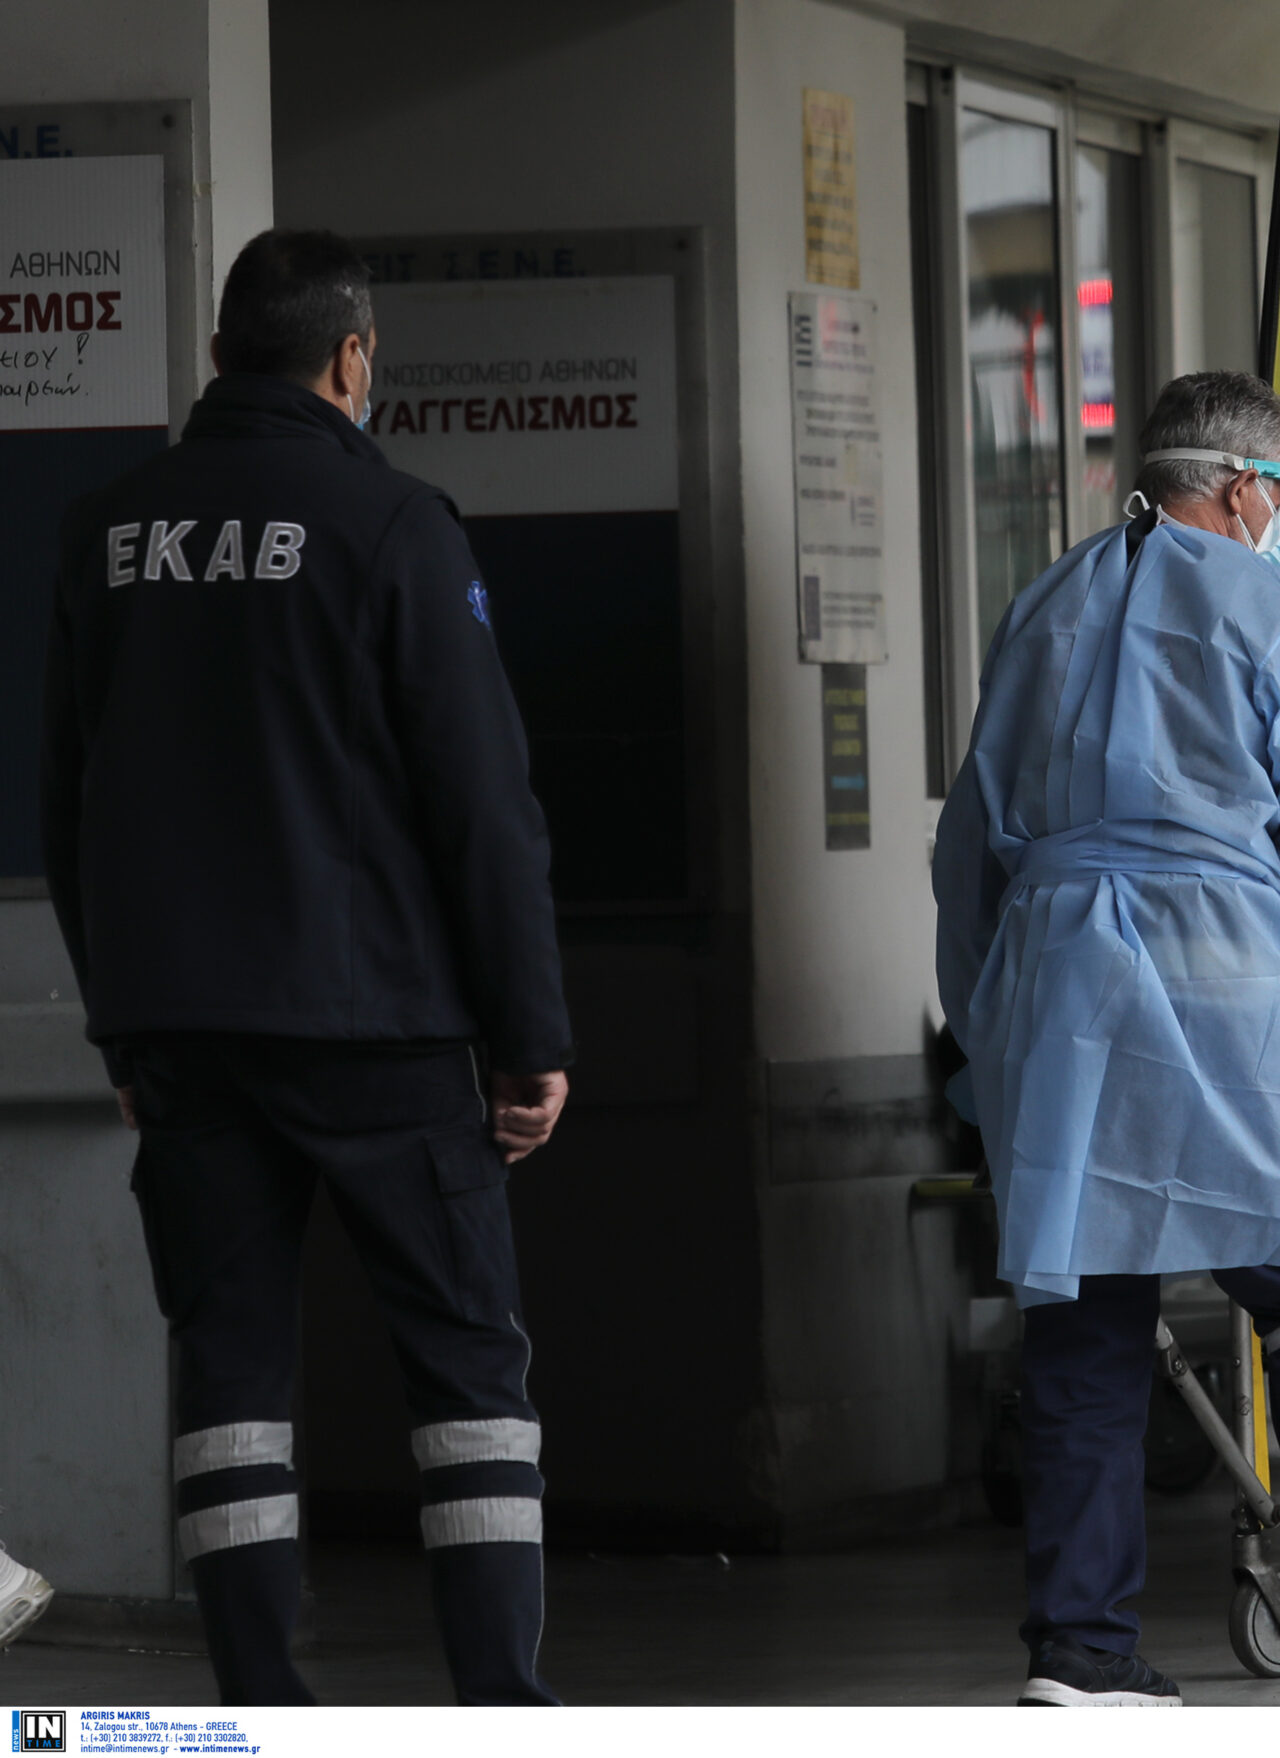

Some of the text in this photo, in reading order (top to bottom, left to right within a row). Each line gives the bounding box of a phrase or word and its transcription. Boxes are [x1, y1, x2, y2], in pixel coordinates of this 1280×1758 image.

[10, 250, 121, 279] ΑΘΗΝΩΝ
[0, 291, 122, 333] ΣΜΟΣ
[384, 357, 638, 388] ΝΟΣΟΚΟΜΕΙΟ ΑΘΗΝΩΝ
[106, 519, 307, 589] ΕΚΑΒ
